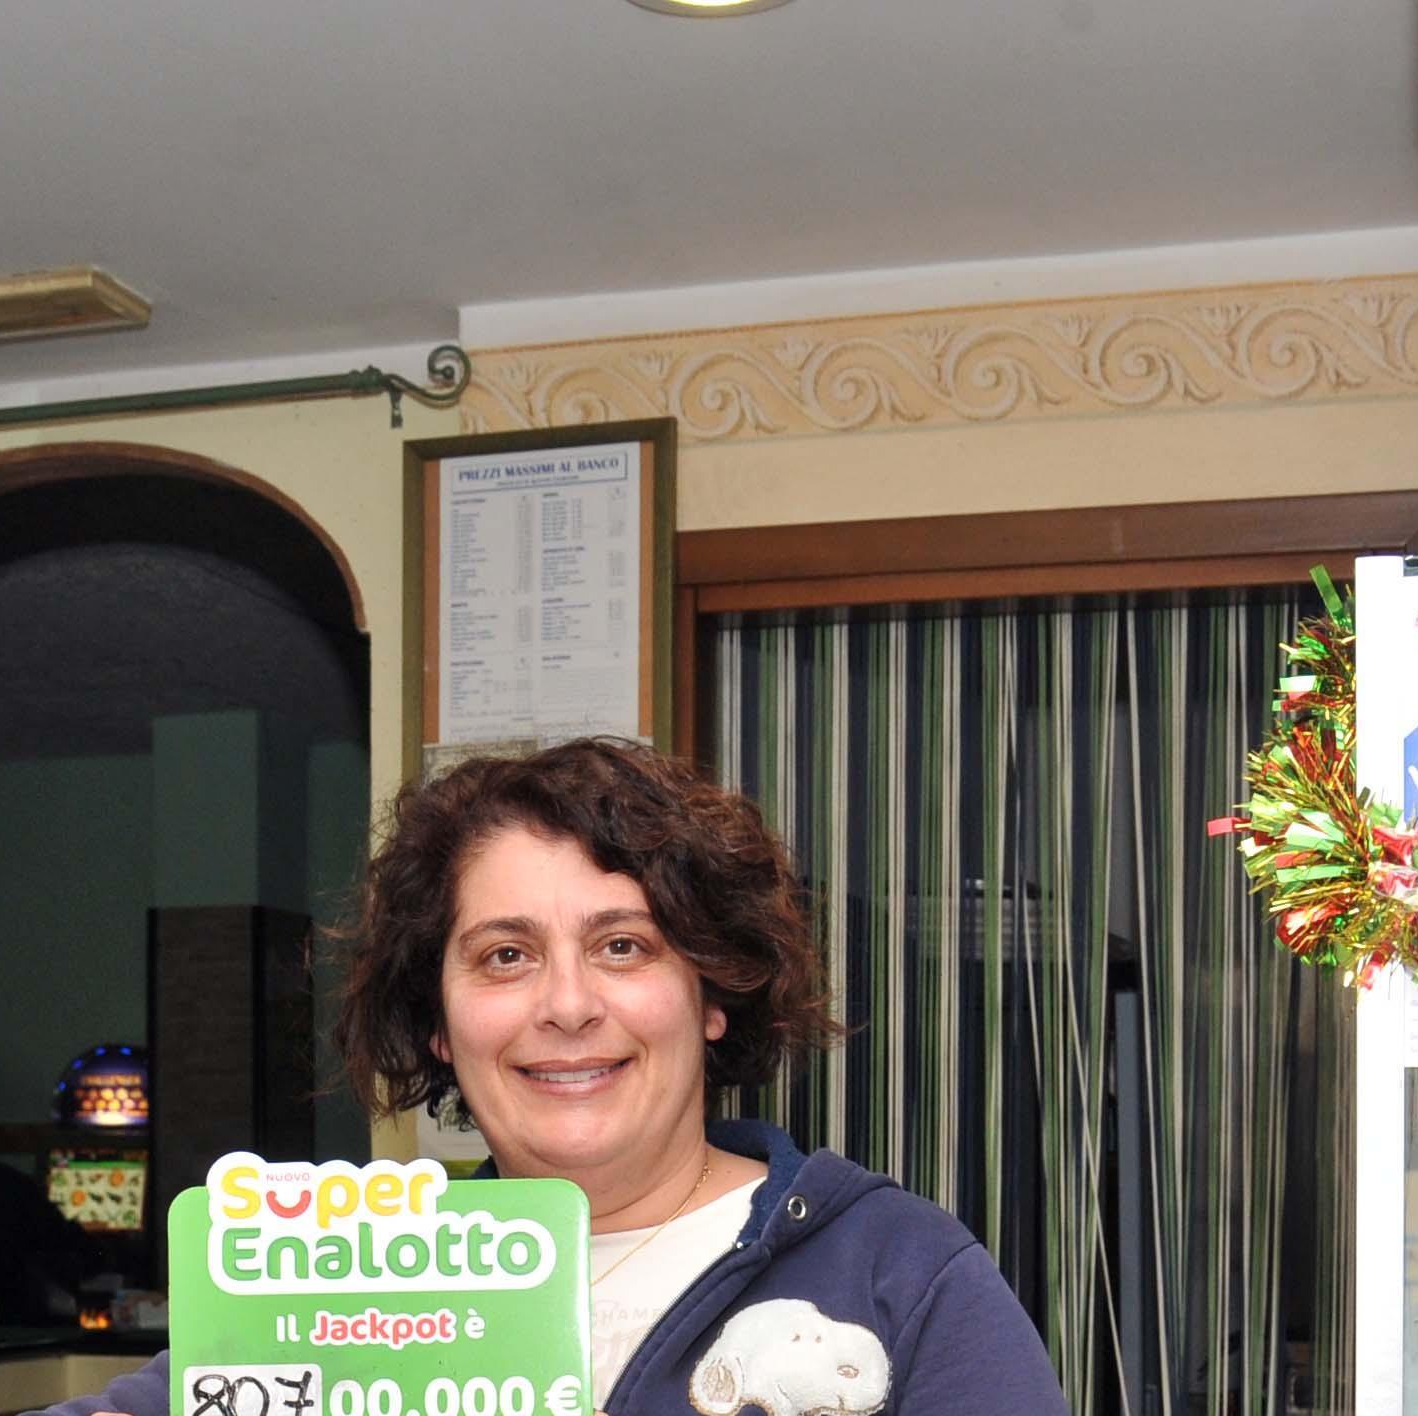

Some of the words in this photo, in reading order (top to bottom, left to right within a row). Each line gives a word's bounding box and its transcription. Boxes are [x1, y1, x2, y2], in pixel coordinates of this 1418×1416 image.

[458, 465, 501, 481] PREZZI
[505, 462, 555, 478] MASSIMI
[560, 461, 572, 473] AL
[577, 457, 620, 471] BANCO
[265, 1172, 311, 1182] NUOVO
[220, 1165, 434, 1230] Super
[221, 1221, 542, 1282] Enalotto
[276, 1313, 301, 1343] Il
[313, 1310, 455, 1346] Jackpot
[465, 1308, 486, 1336] è
